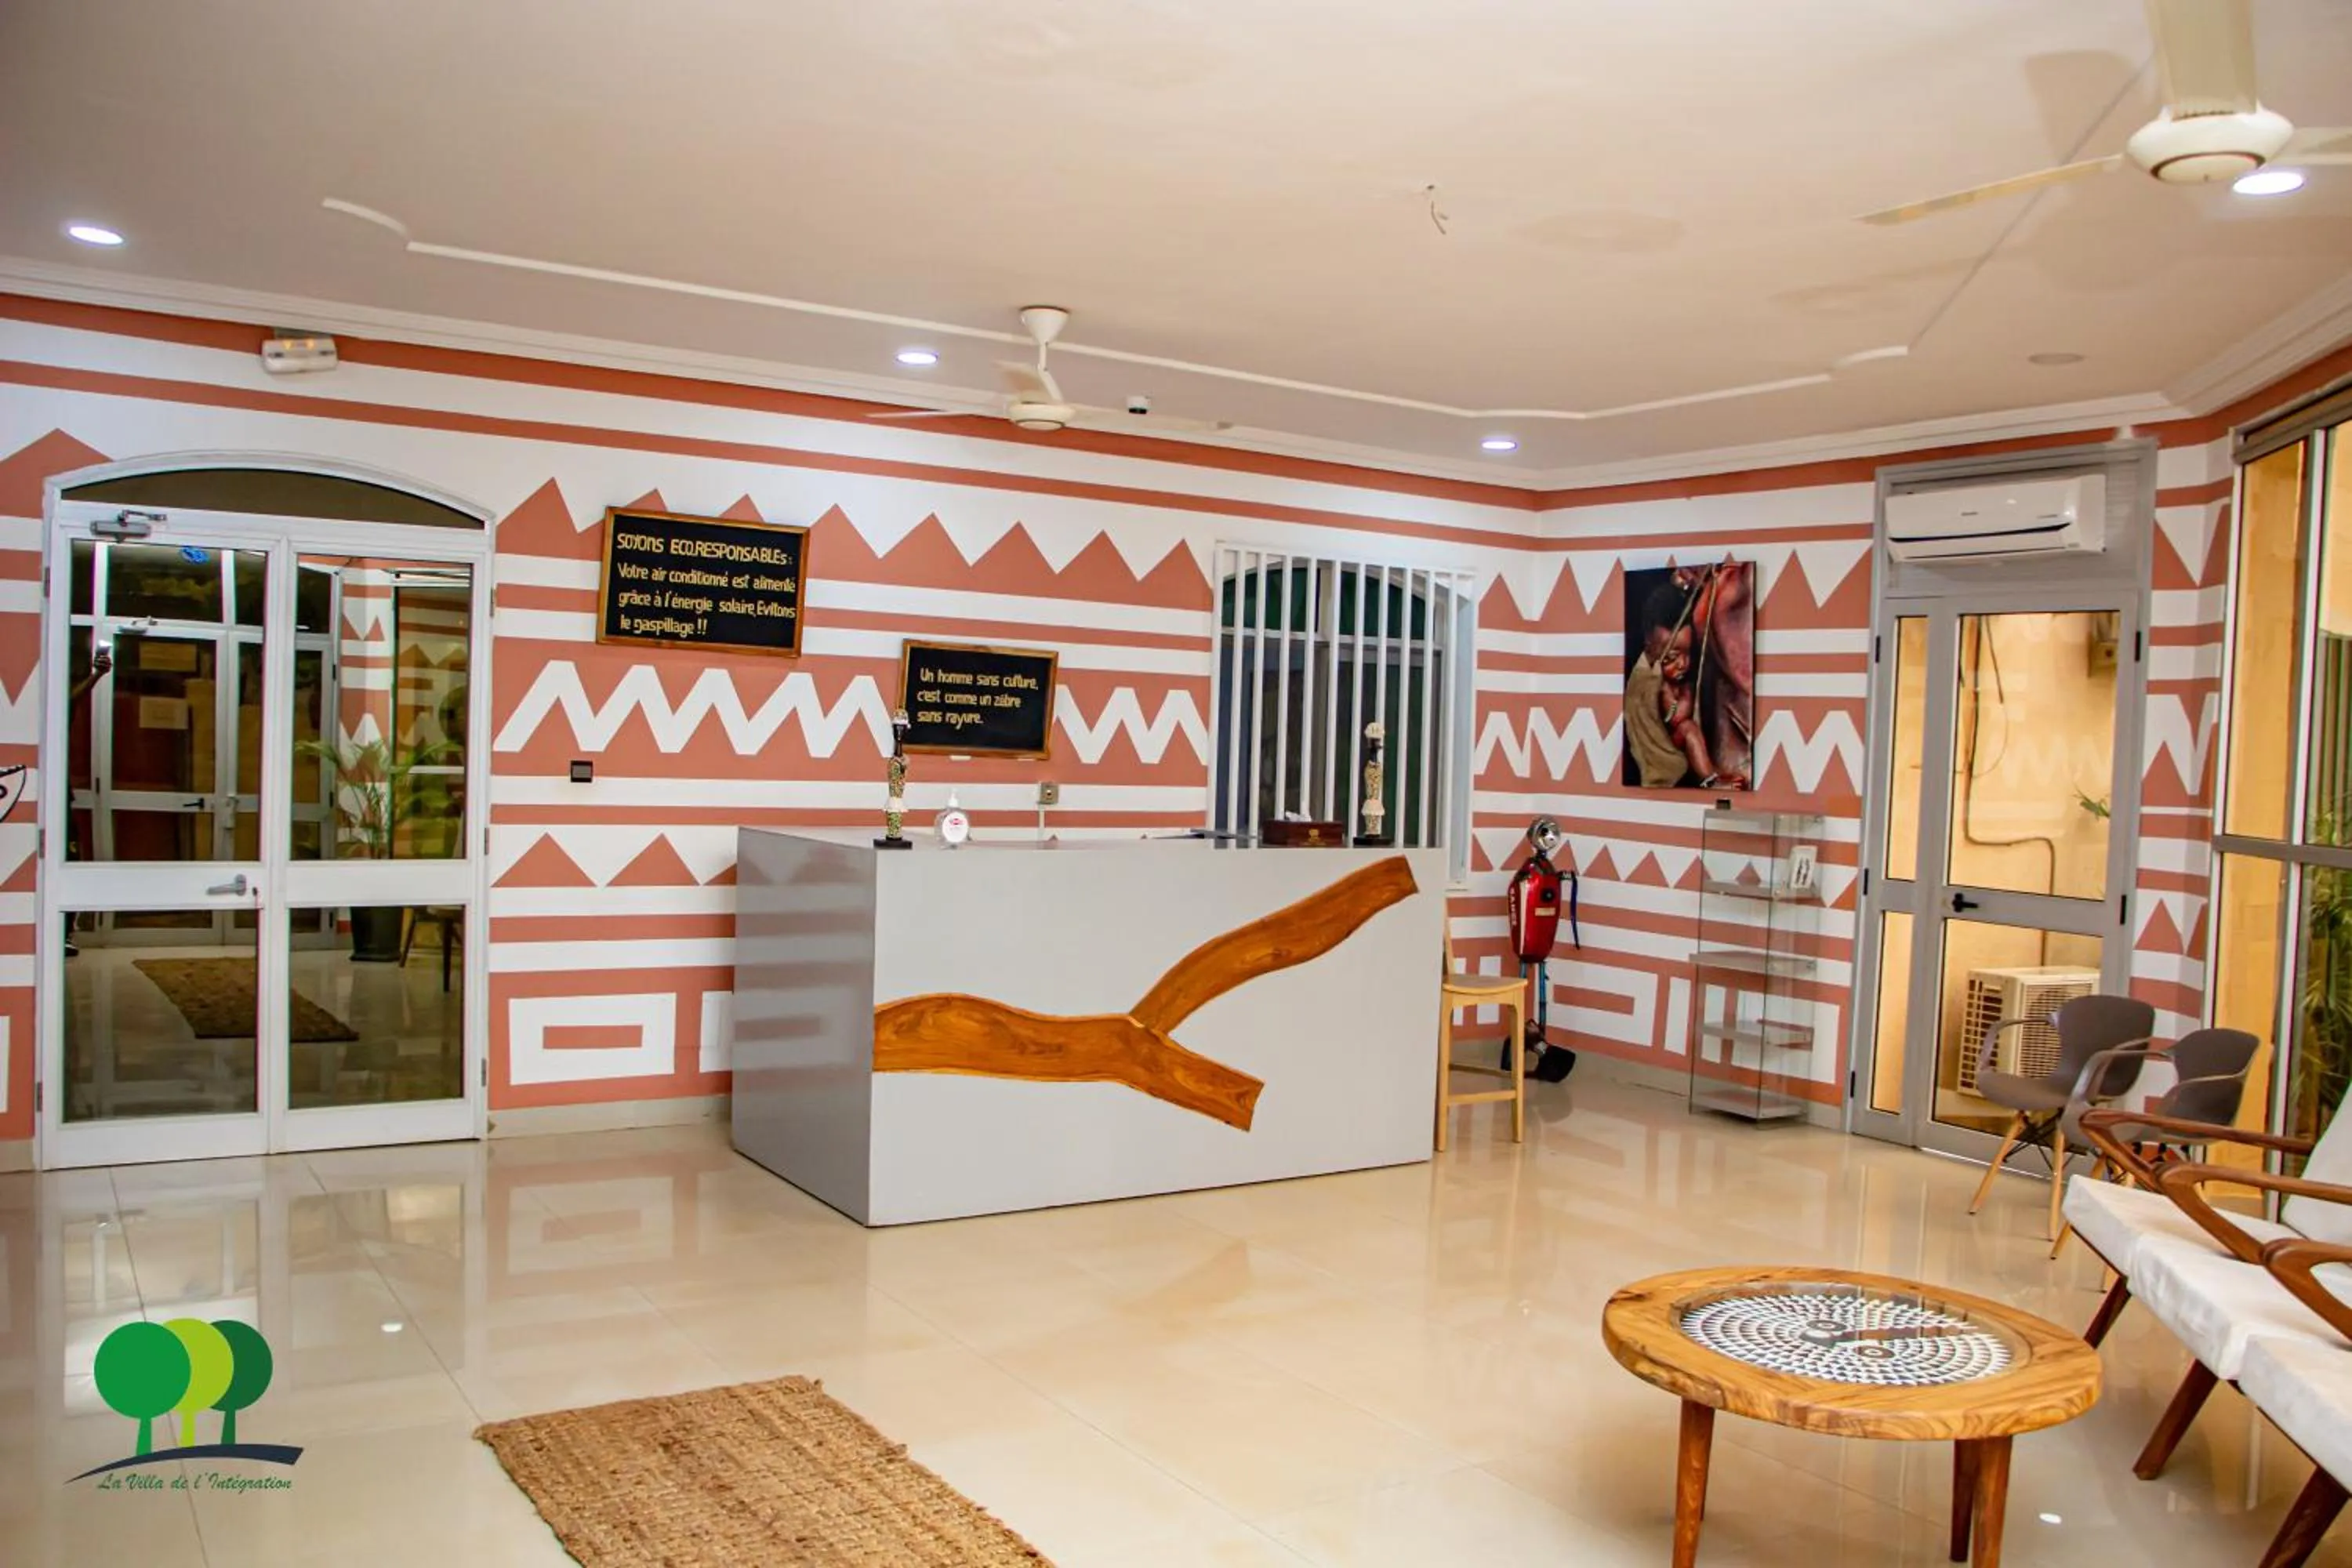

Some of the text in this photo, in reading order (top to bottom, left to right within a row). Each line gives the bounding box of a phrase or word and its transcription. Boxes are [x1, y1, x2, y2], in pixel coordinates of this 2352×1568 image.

[617, 562, 796, 593] Votre air conditionné est alimenté
[618, 589, 652, 608] grâce
[653, 590, 662, 607] à
[620, 614, 631, 630] le
[633, 617, 695, 638] gaspillage
[920, 667, 934, 683] Un
[937, 668, 973, 684] homme
[976, 674, 1000, 687] sans
[916, 689, 941, 703] c'est
[945, 693, 978, 705] comme
[979, 694, 992, 706] un
[916, 710, 943, 724] sans
